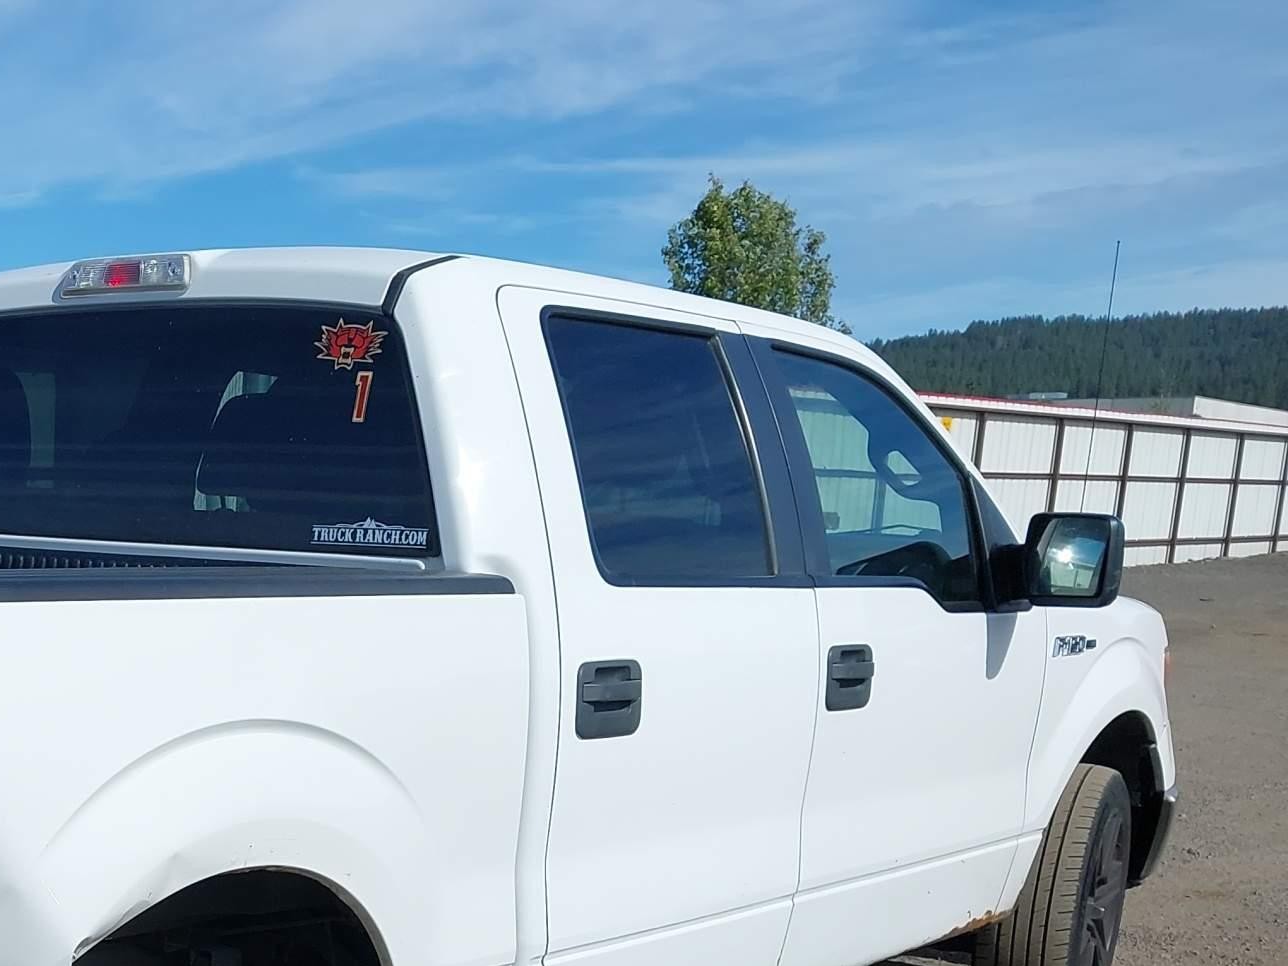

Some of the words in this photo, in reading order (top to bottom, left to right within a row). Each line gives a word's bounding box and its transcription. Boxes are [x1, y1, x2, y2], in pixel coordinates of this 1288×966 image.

[352, 371, 373, 422] 1
[312, 527, 354, 542] TRUCK
[355, 528, 428, 545] RANCH.COM
